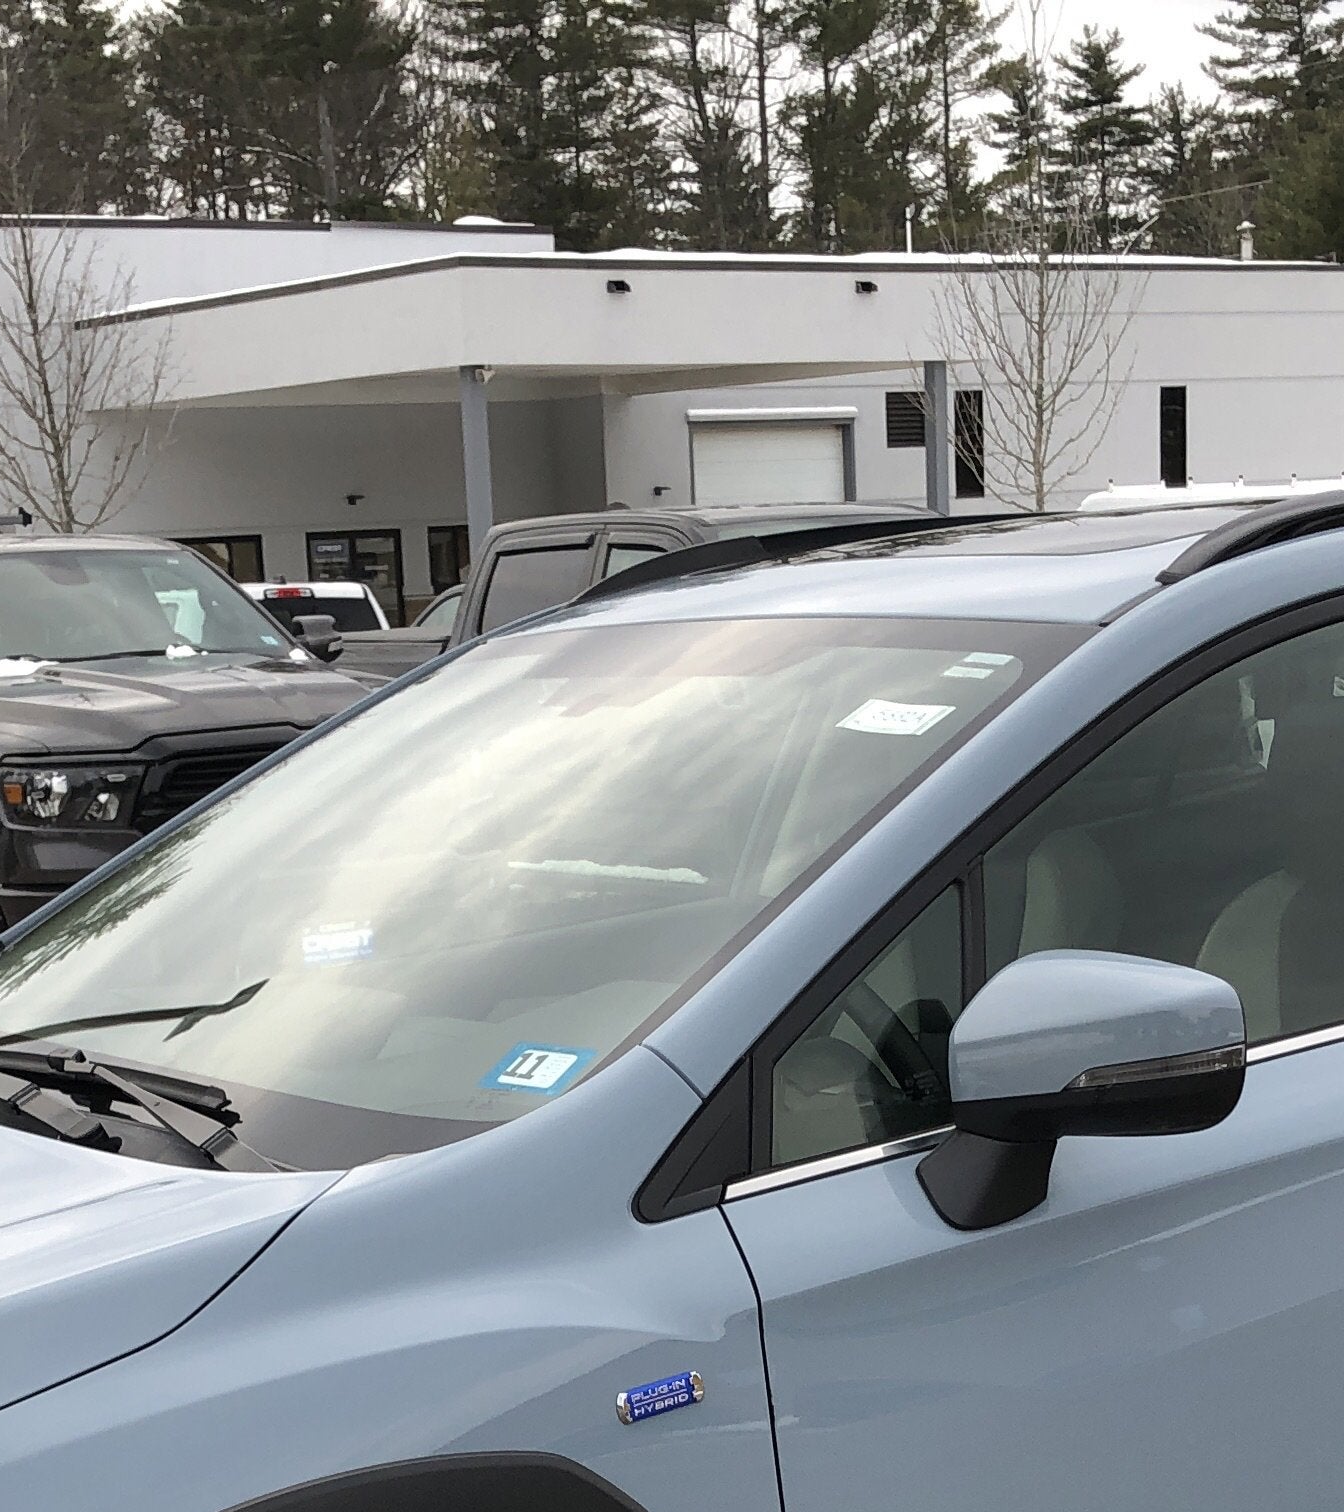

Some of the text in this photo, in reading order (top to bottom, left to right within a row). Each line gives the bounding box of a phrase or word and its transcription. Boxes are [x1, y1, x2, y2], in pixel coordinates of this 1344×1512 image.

[502, 1052, 549, 1080] 11
[630, 1378, 687, 1404] PLUG-IN
[633, 1393, 689, 1417] HYBRID
